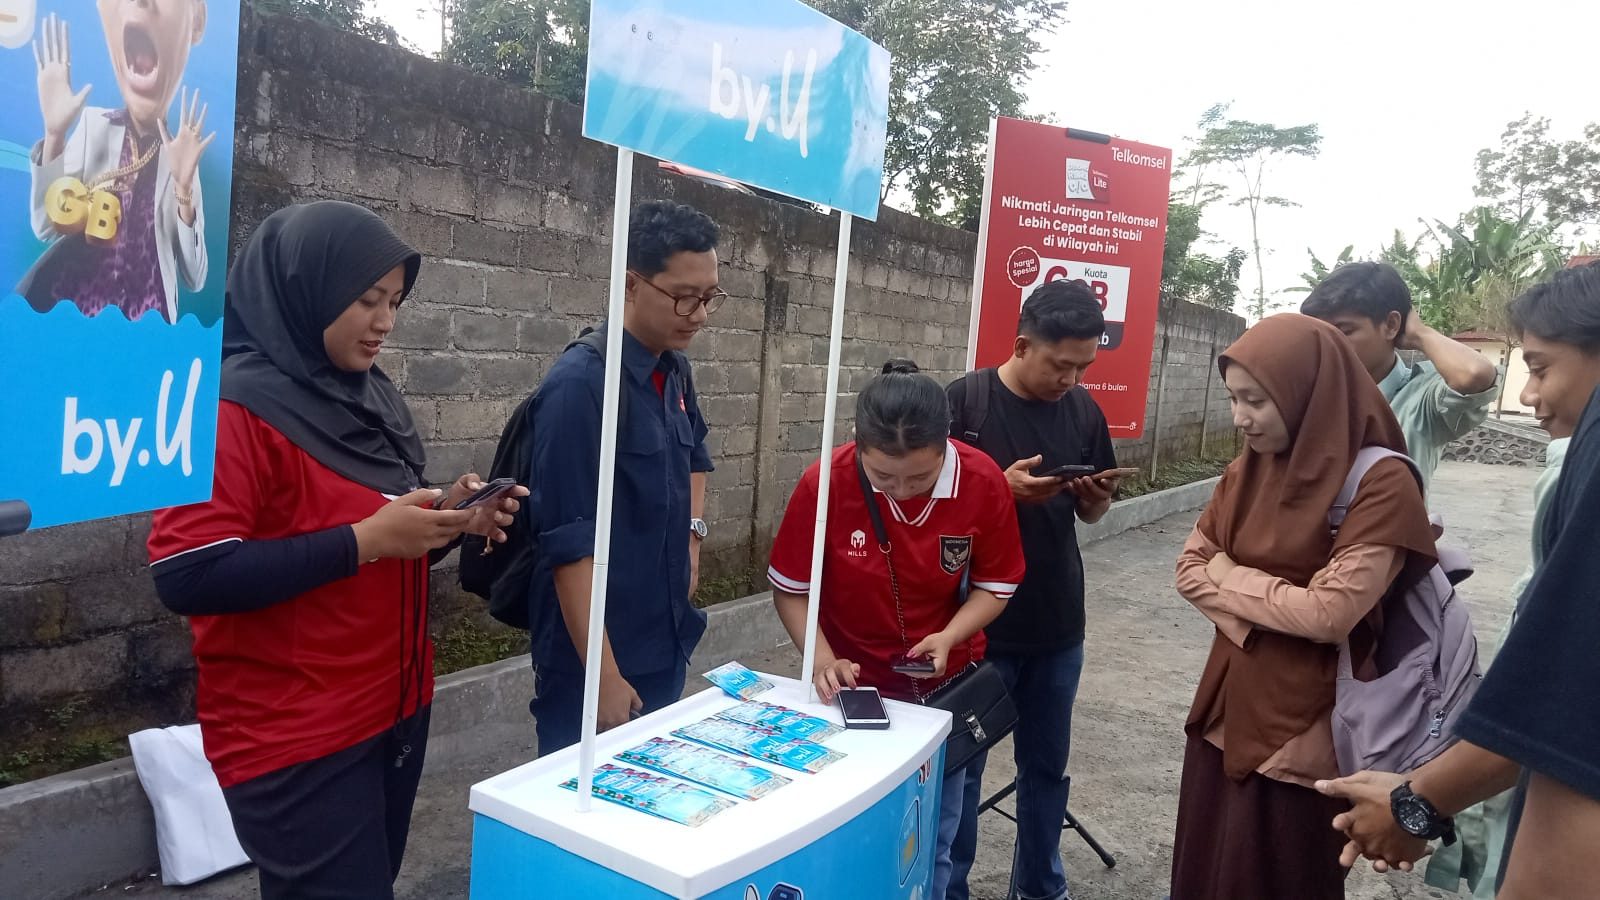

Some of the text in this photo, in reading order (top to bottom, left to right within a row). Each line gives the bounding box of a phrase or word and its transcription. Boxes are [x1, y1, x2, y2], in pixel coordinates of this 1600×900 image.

[709, 41, 817, 158] by.U
[1111, 146, 1166, 170] Telkomsel
[1093, 176, 1108, 189] Lite
[44, 175, 122, 243] GB
[1001, 195, 1159, 228] Nikmati Jaringan Telkomsel
[1018, 215, 1142, 242] Lebih Cepat dan Stabil
[1043, 234, 1119, 255] di Wilayah ini
[1013, 258, 1035, 268] harga
[1084, 267, 1108, 279] Kuota
[1107, 382, 1128, 391] bulan
[60, 357, 203, 487] by.U
